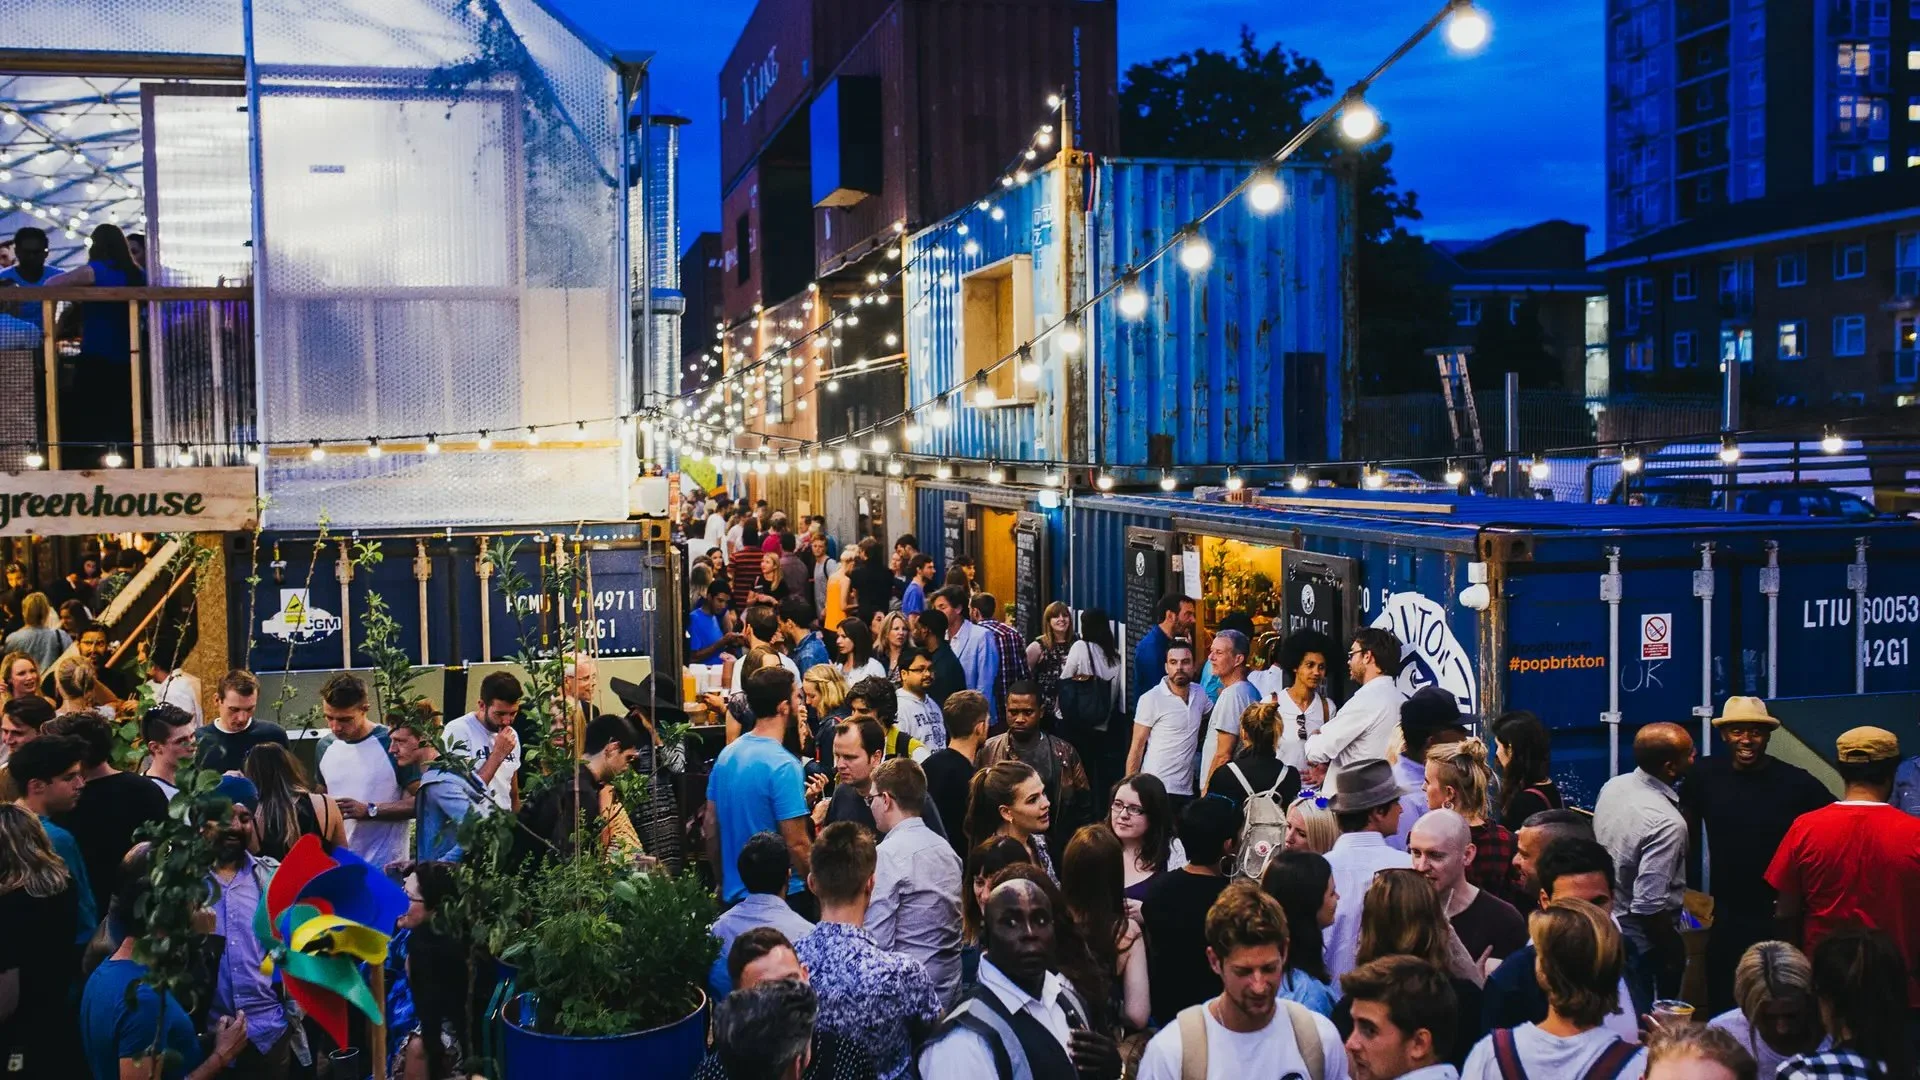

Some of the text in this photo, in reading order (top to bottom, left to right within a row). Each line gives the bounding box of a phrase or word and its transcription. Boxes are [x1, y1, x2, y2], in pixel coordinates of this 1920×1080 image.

[0, 485, 205, 528] greenhouse
[1804, 598, 1851, 628] LTIU
[1509, 654, 1606, 673] #popbrixton
